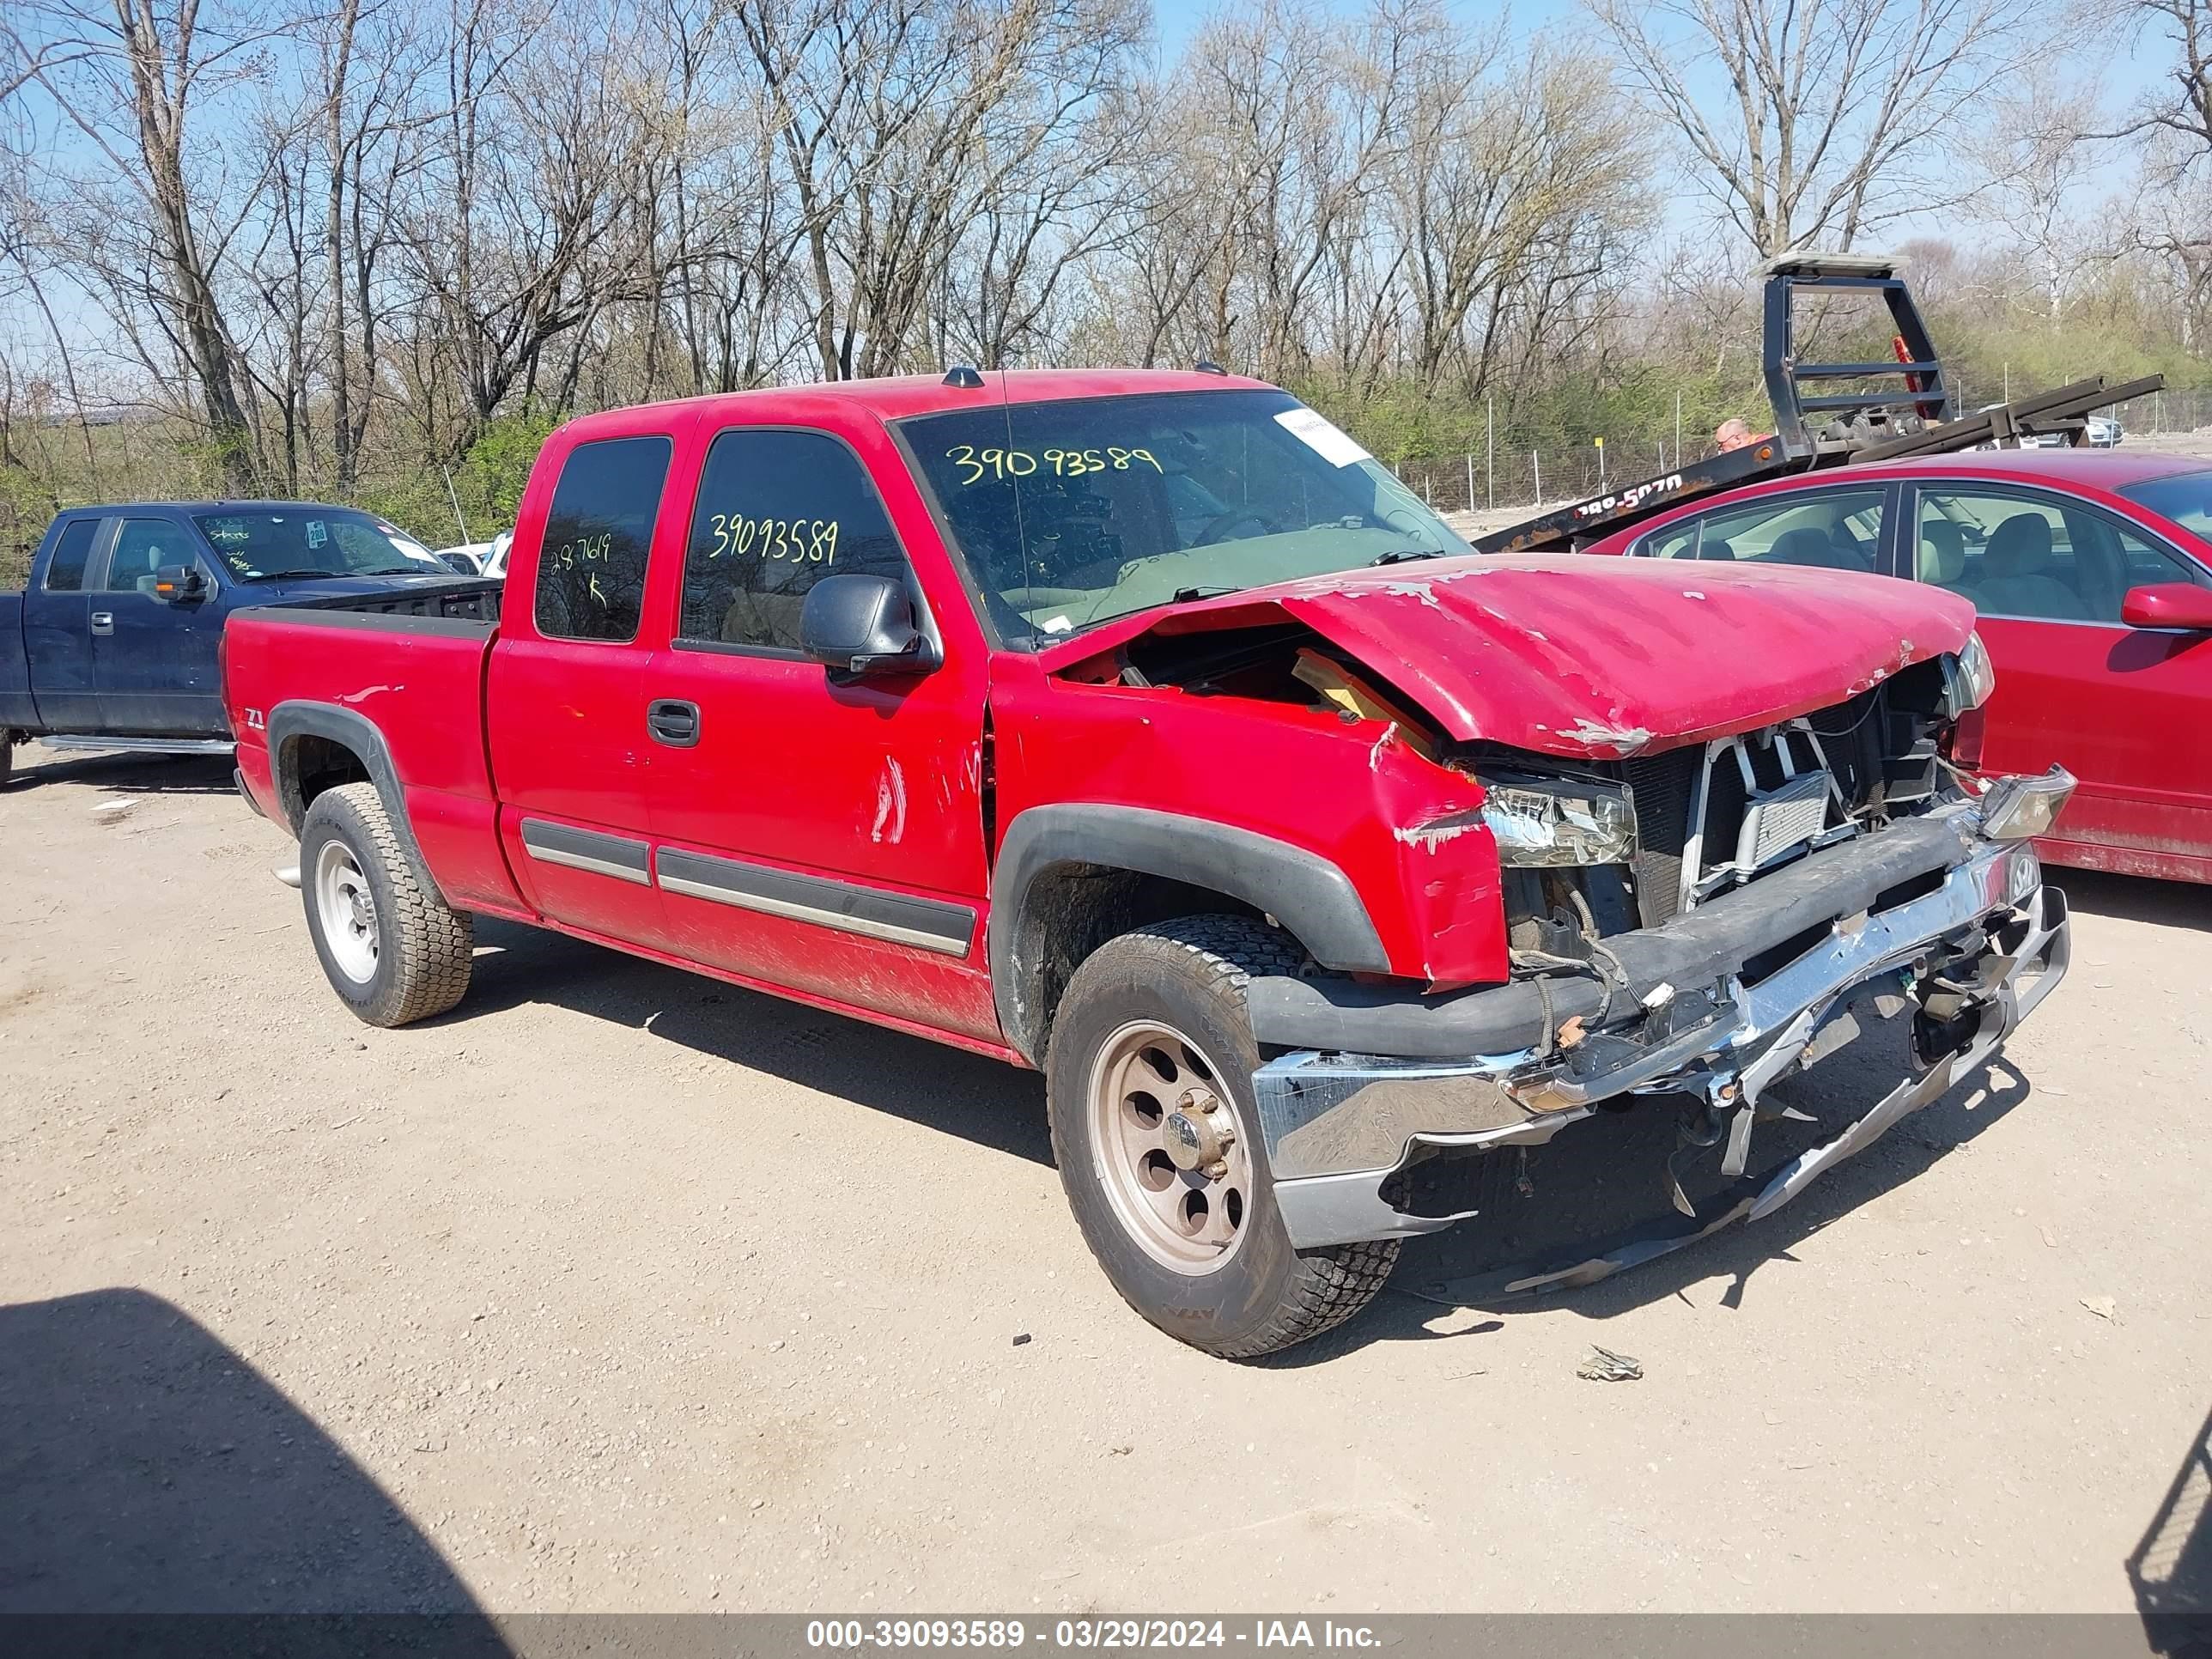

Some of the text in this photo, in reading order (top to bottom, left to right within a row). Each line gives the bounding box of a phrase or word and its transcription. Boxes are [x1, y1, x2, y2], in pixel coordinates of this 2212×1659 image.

[945, 446, 1164, 485] 39093589
[310, 529, 325, 541] 288
[708, 514, 838, 567] 39093589
